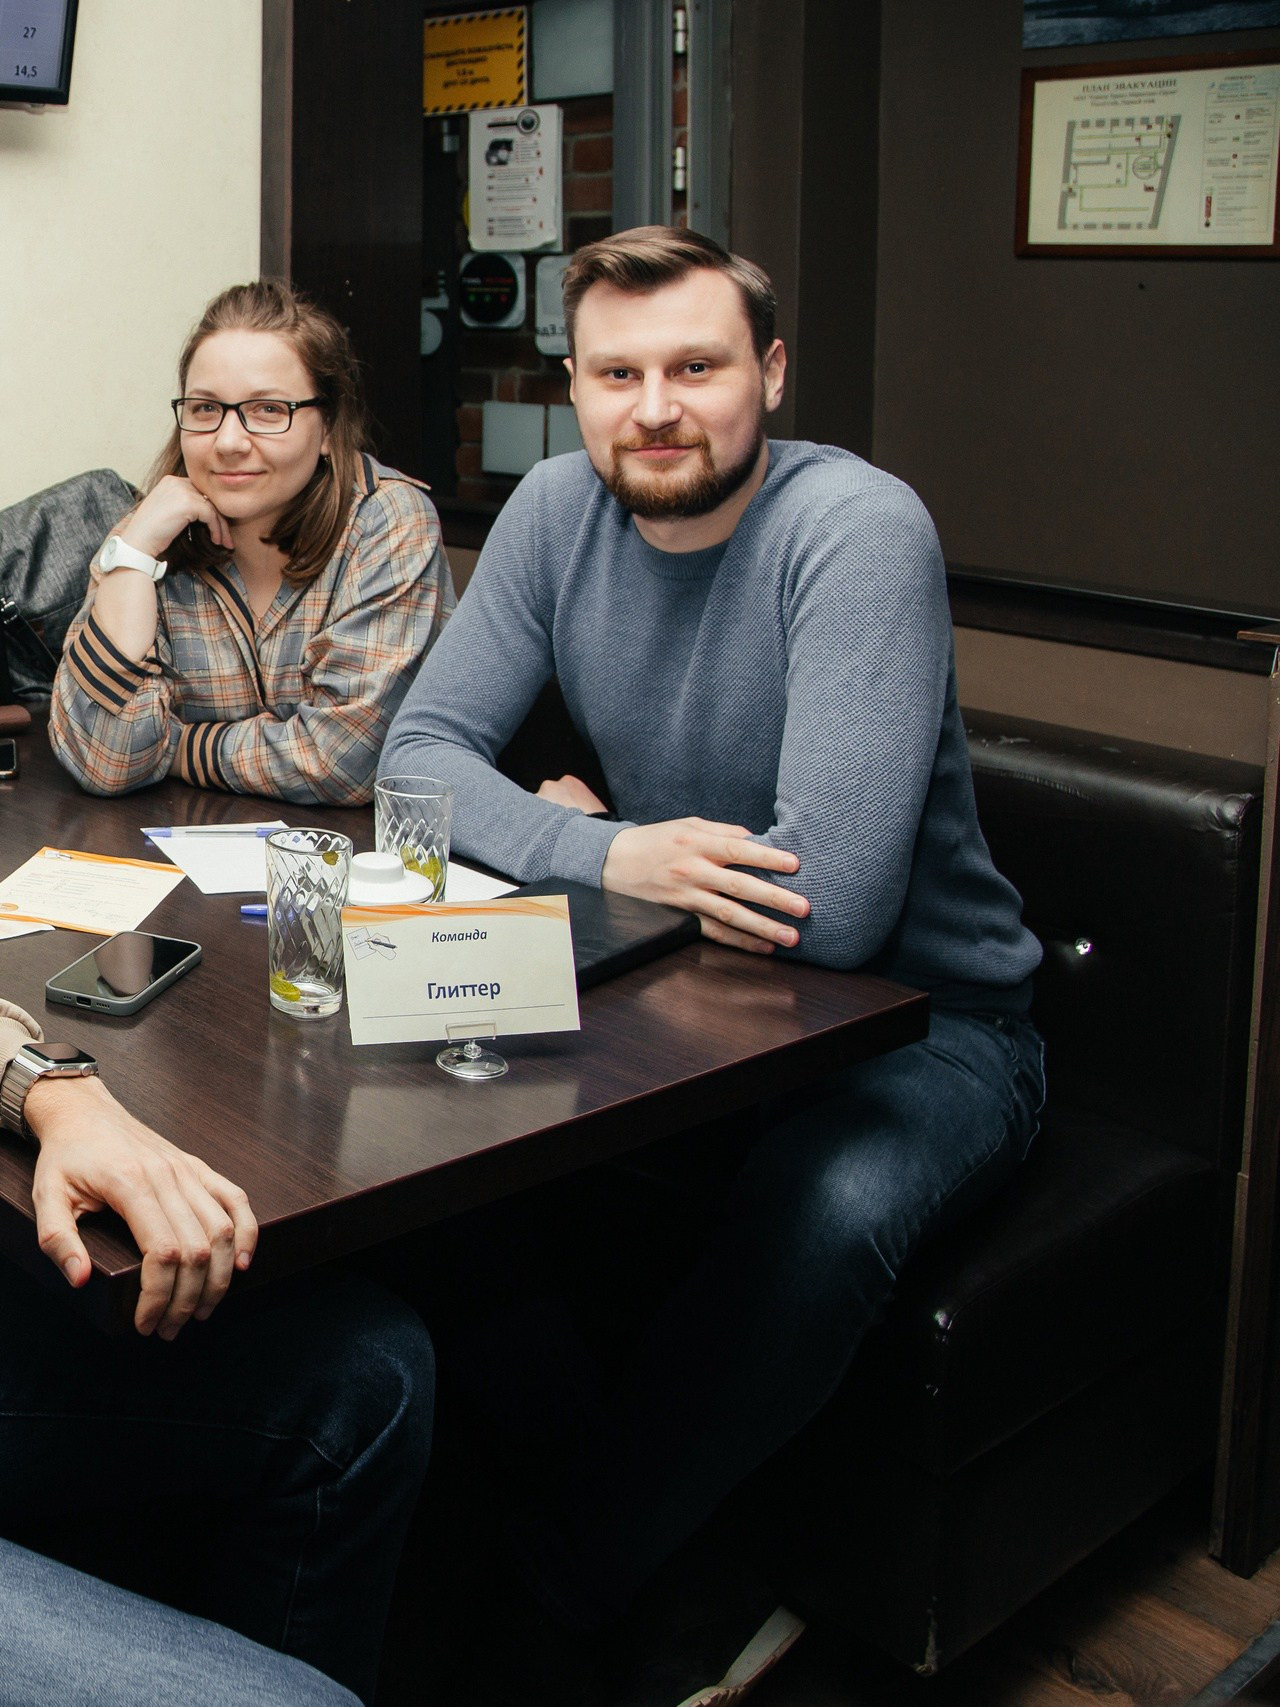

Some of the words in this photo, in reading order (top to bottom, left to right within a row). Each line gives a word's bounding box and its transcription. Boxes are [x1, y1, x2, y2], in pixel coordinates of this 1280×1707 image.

[22, 26, 37, 39] 27
[14, 64, 38, 78] 14,5
[431, 928, 488, 943] Команда
[427, 982, 501, 1000] Глиттер
